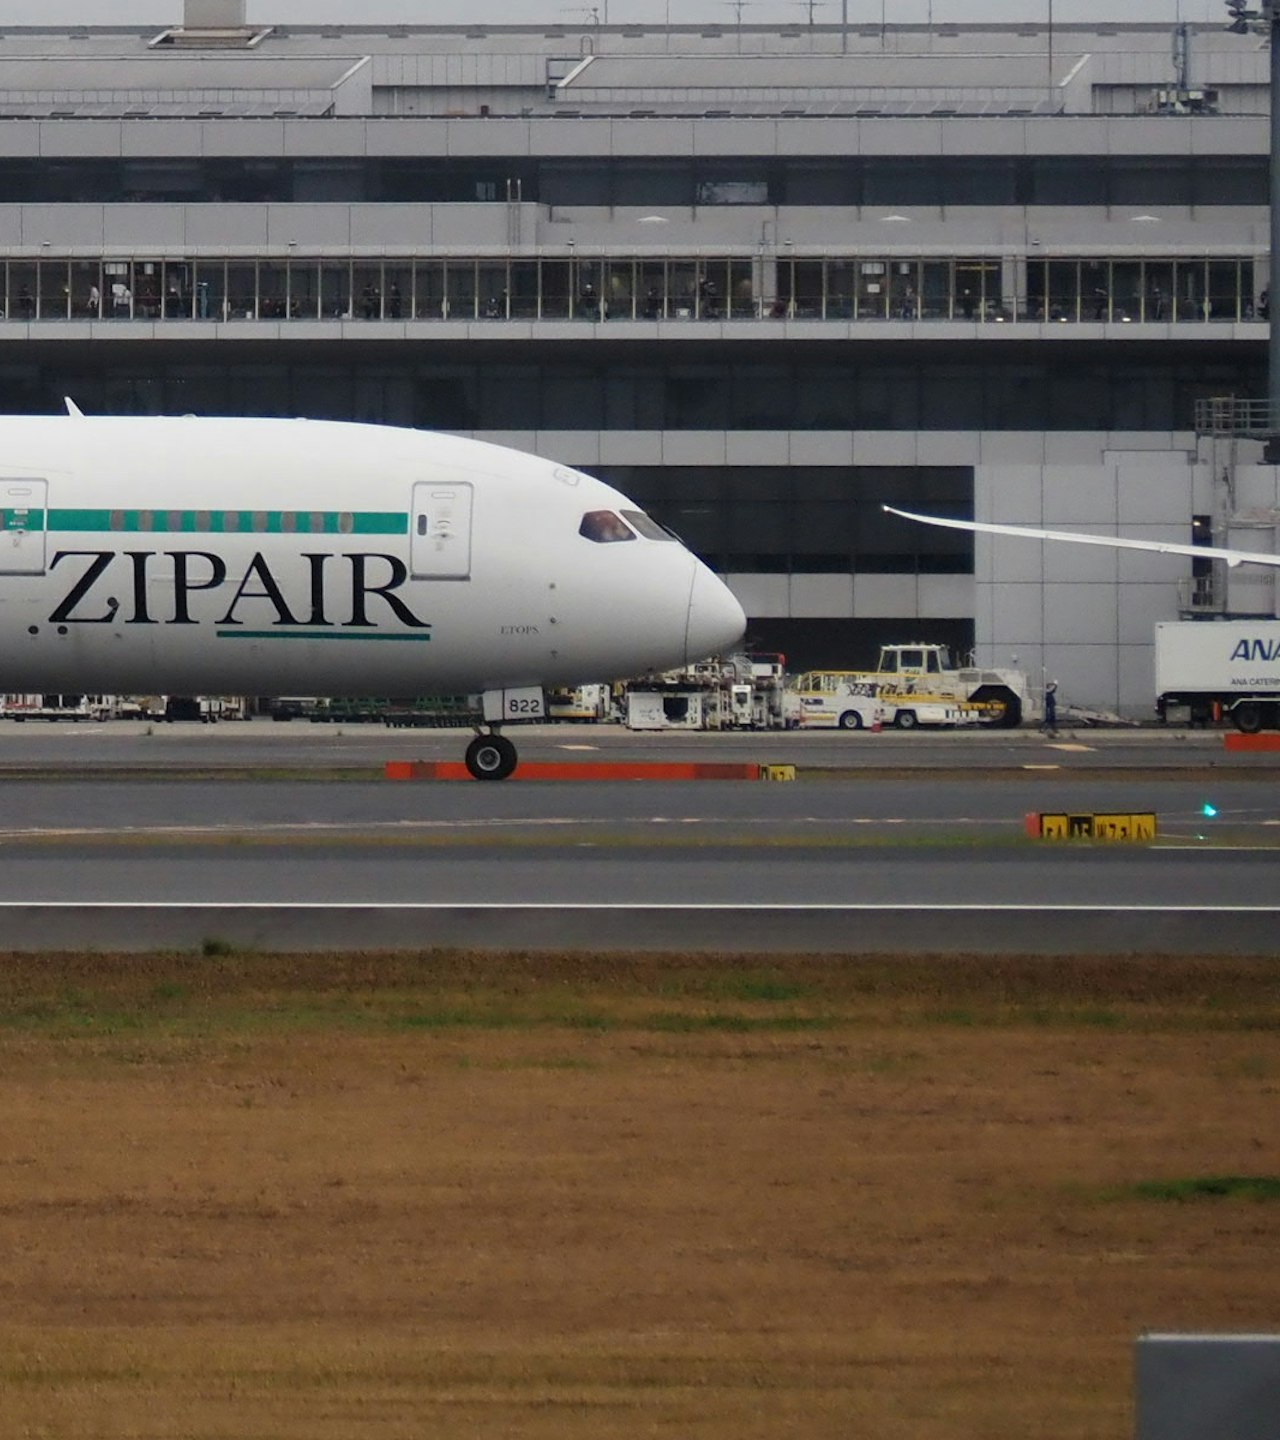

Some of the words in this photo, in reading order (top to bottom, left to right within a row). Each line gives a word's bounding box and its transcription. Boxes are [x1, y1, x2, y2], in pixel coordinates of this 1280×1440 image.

[48, 551, 432, 628] ZIPAIR
[500, 625, 540, 635] ETOPS
[510, 699, 540, 713] 822
